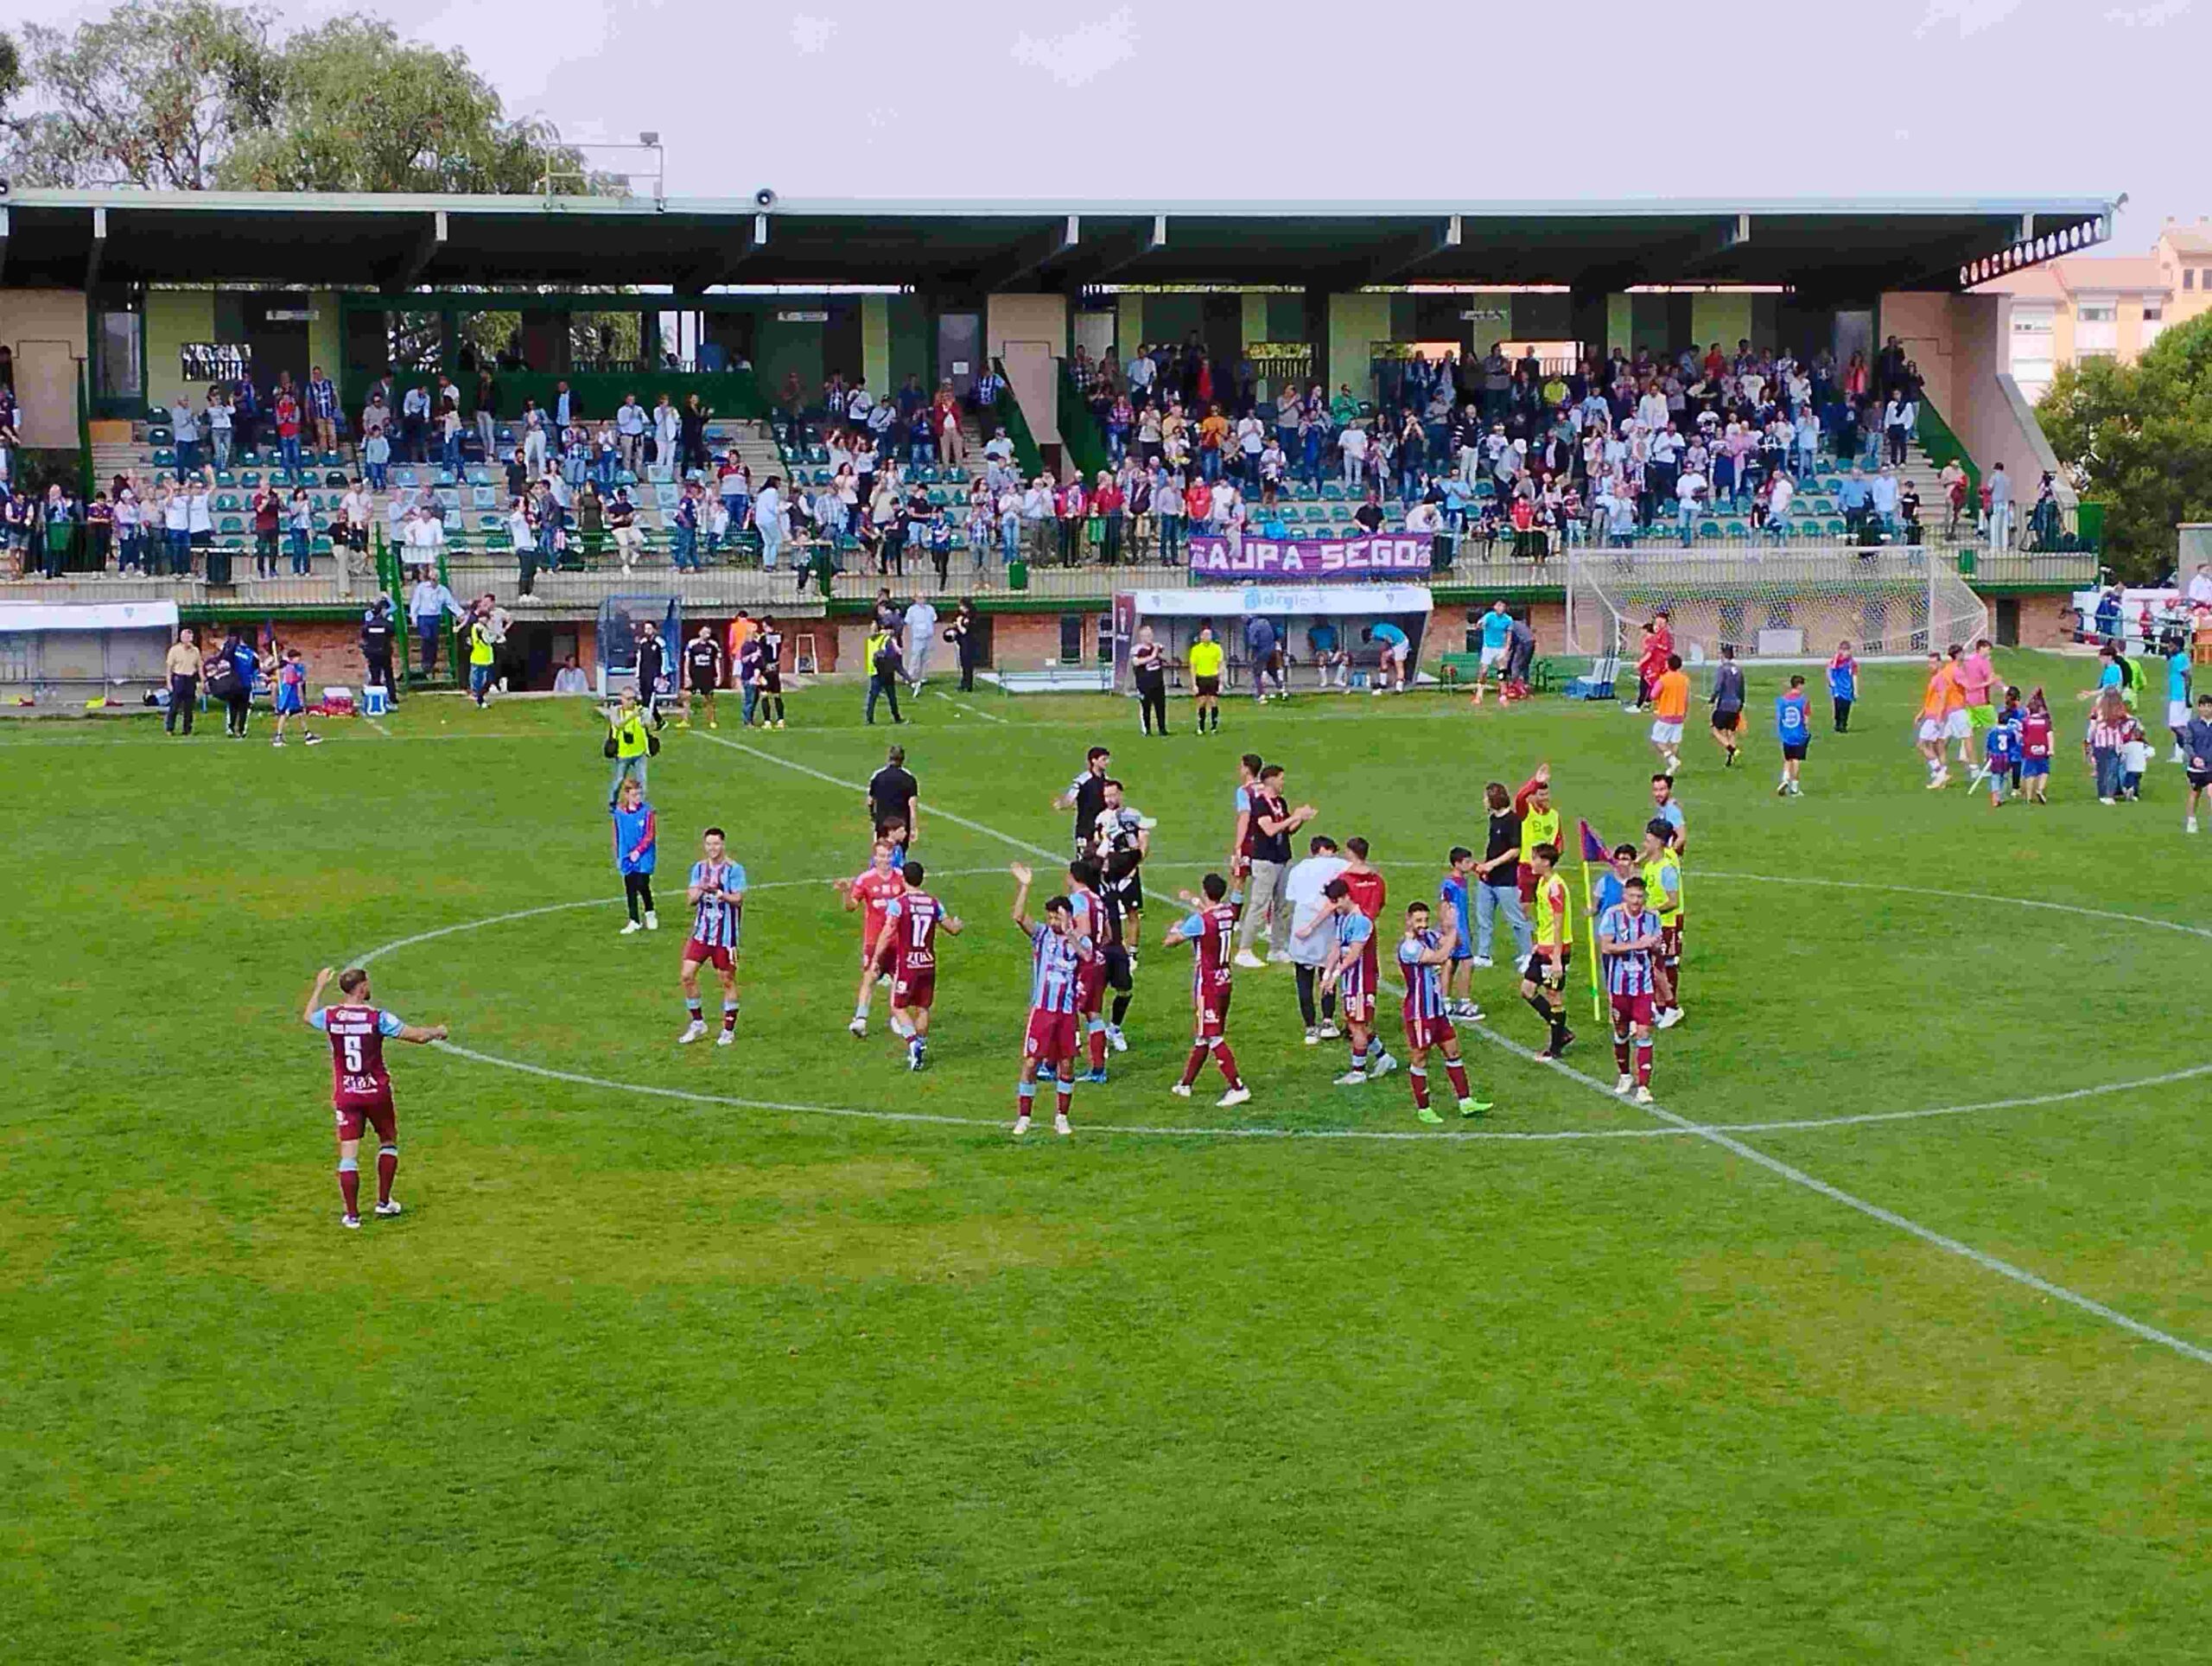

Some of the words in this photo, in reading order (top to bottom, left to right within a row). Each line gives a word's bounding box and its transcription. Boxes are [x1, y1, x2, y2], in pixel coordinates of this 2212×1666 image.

[1211, 543, 1304, 570] AUPA
[1321, 539, 1418, 570] SEGO
[912, 914, 932, 947] 17
[343, 1035, 362, 1072] 5
